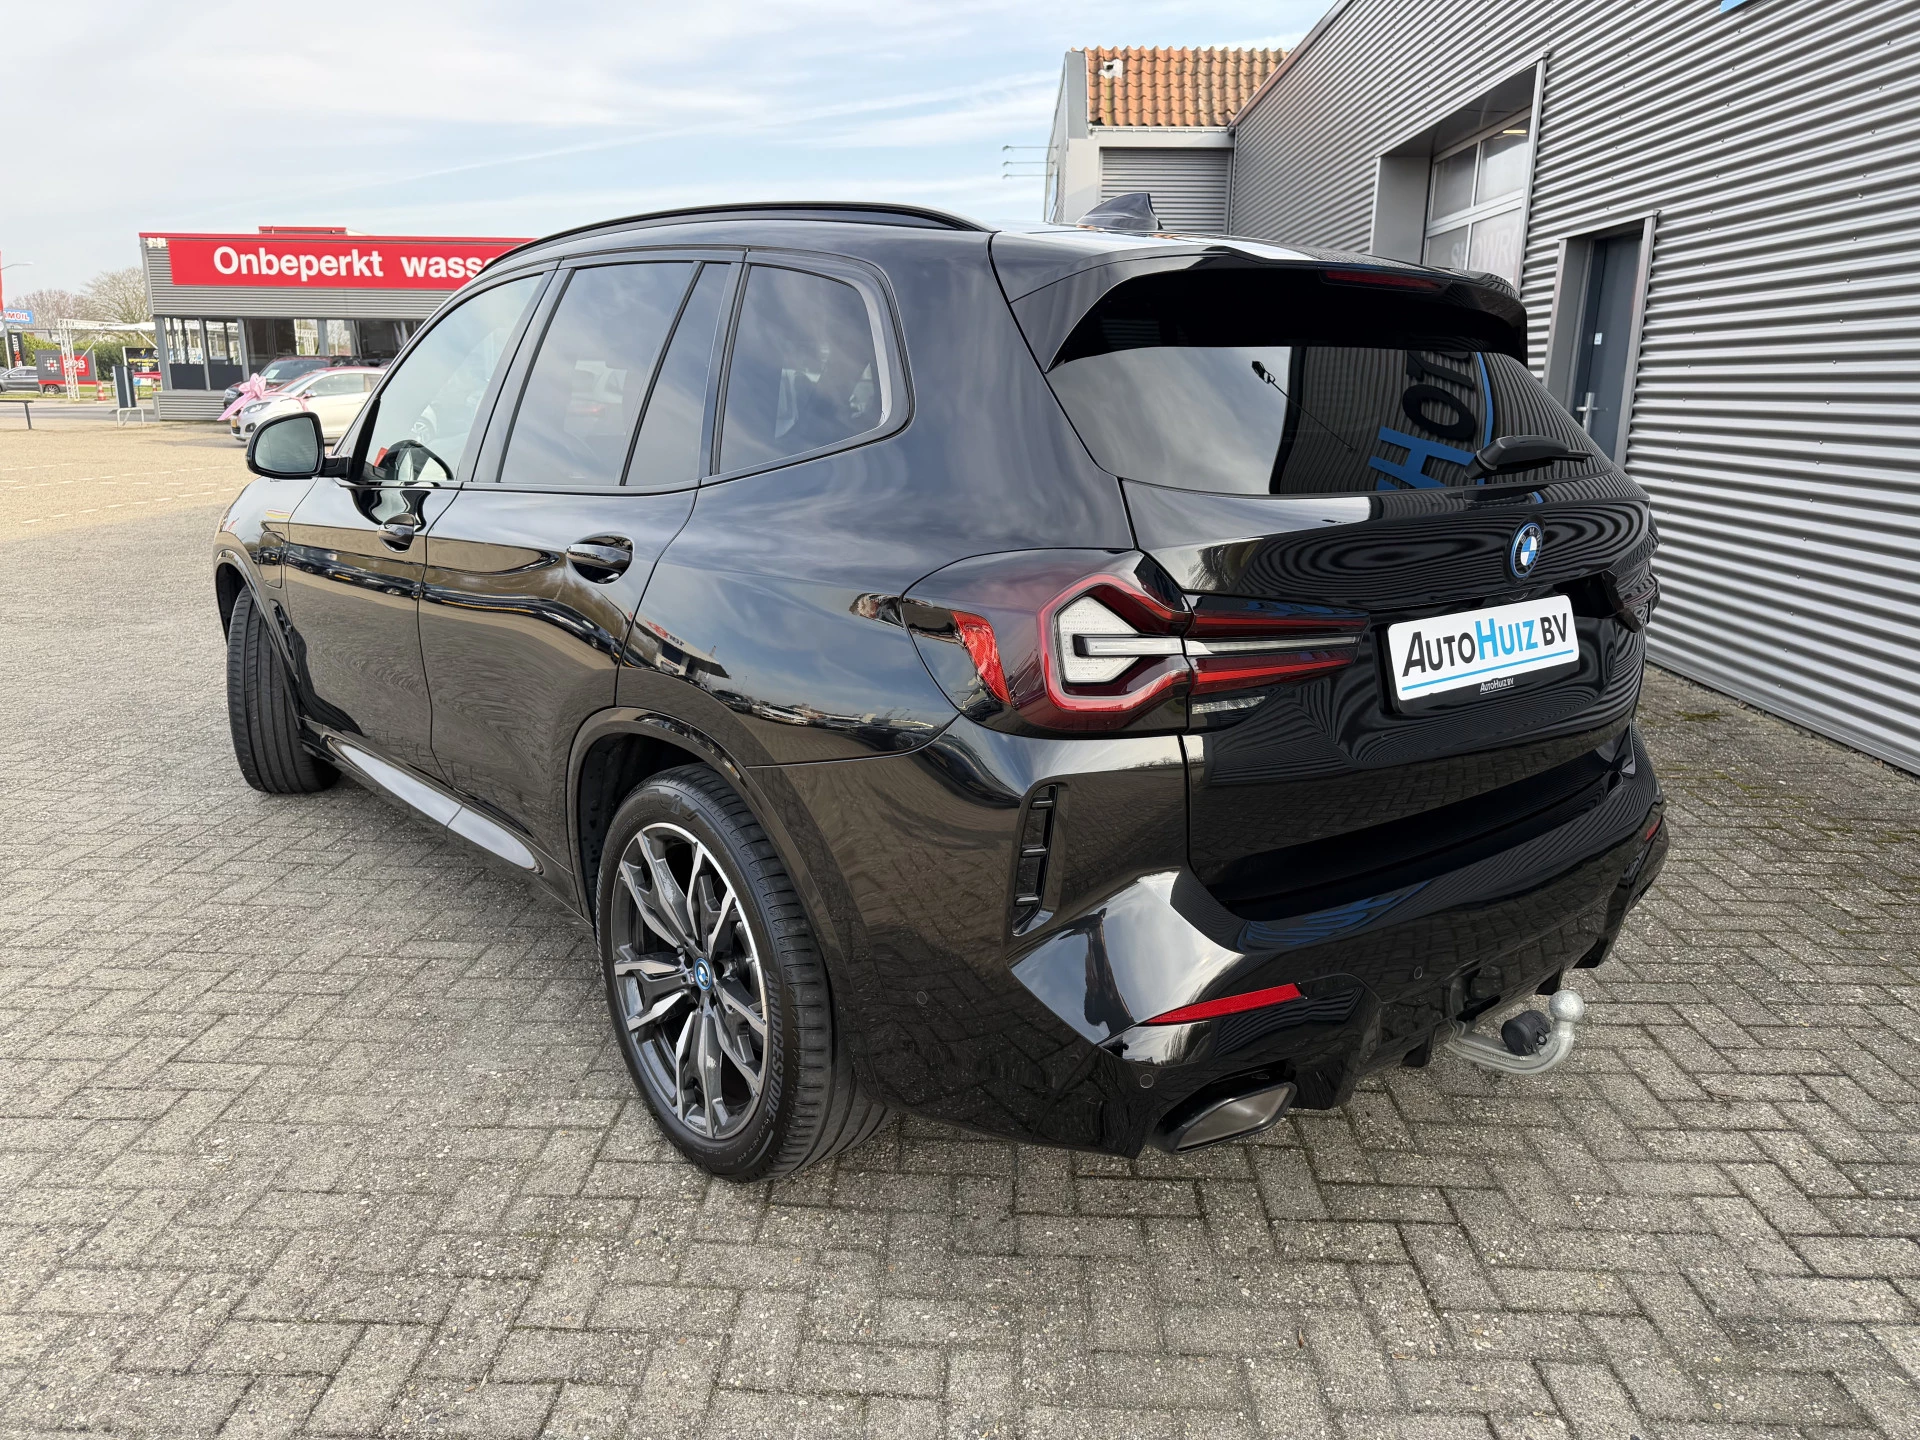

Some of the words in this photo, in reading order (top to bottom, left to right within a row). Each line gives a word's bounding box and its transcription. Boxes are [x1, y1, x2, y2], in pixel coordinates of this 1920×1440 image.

[213, 246, 384, 282] Onbeperkt
[1402, 618, 1538, 678] AUTOHUIZ
[1540, 613, 1567, 646] BV
